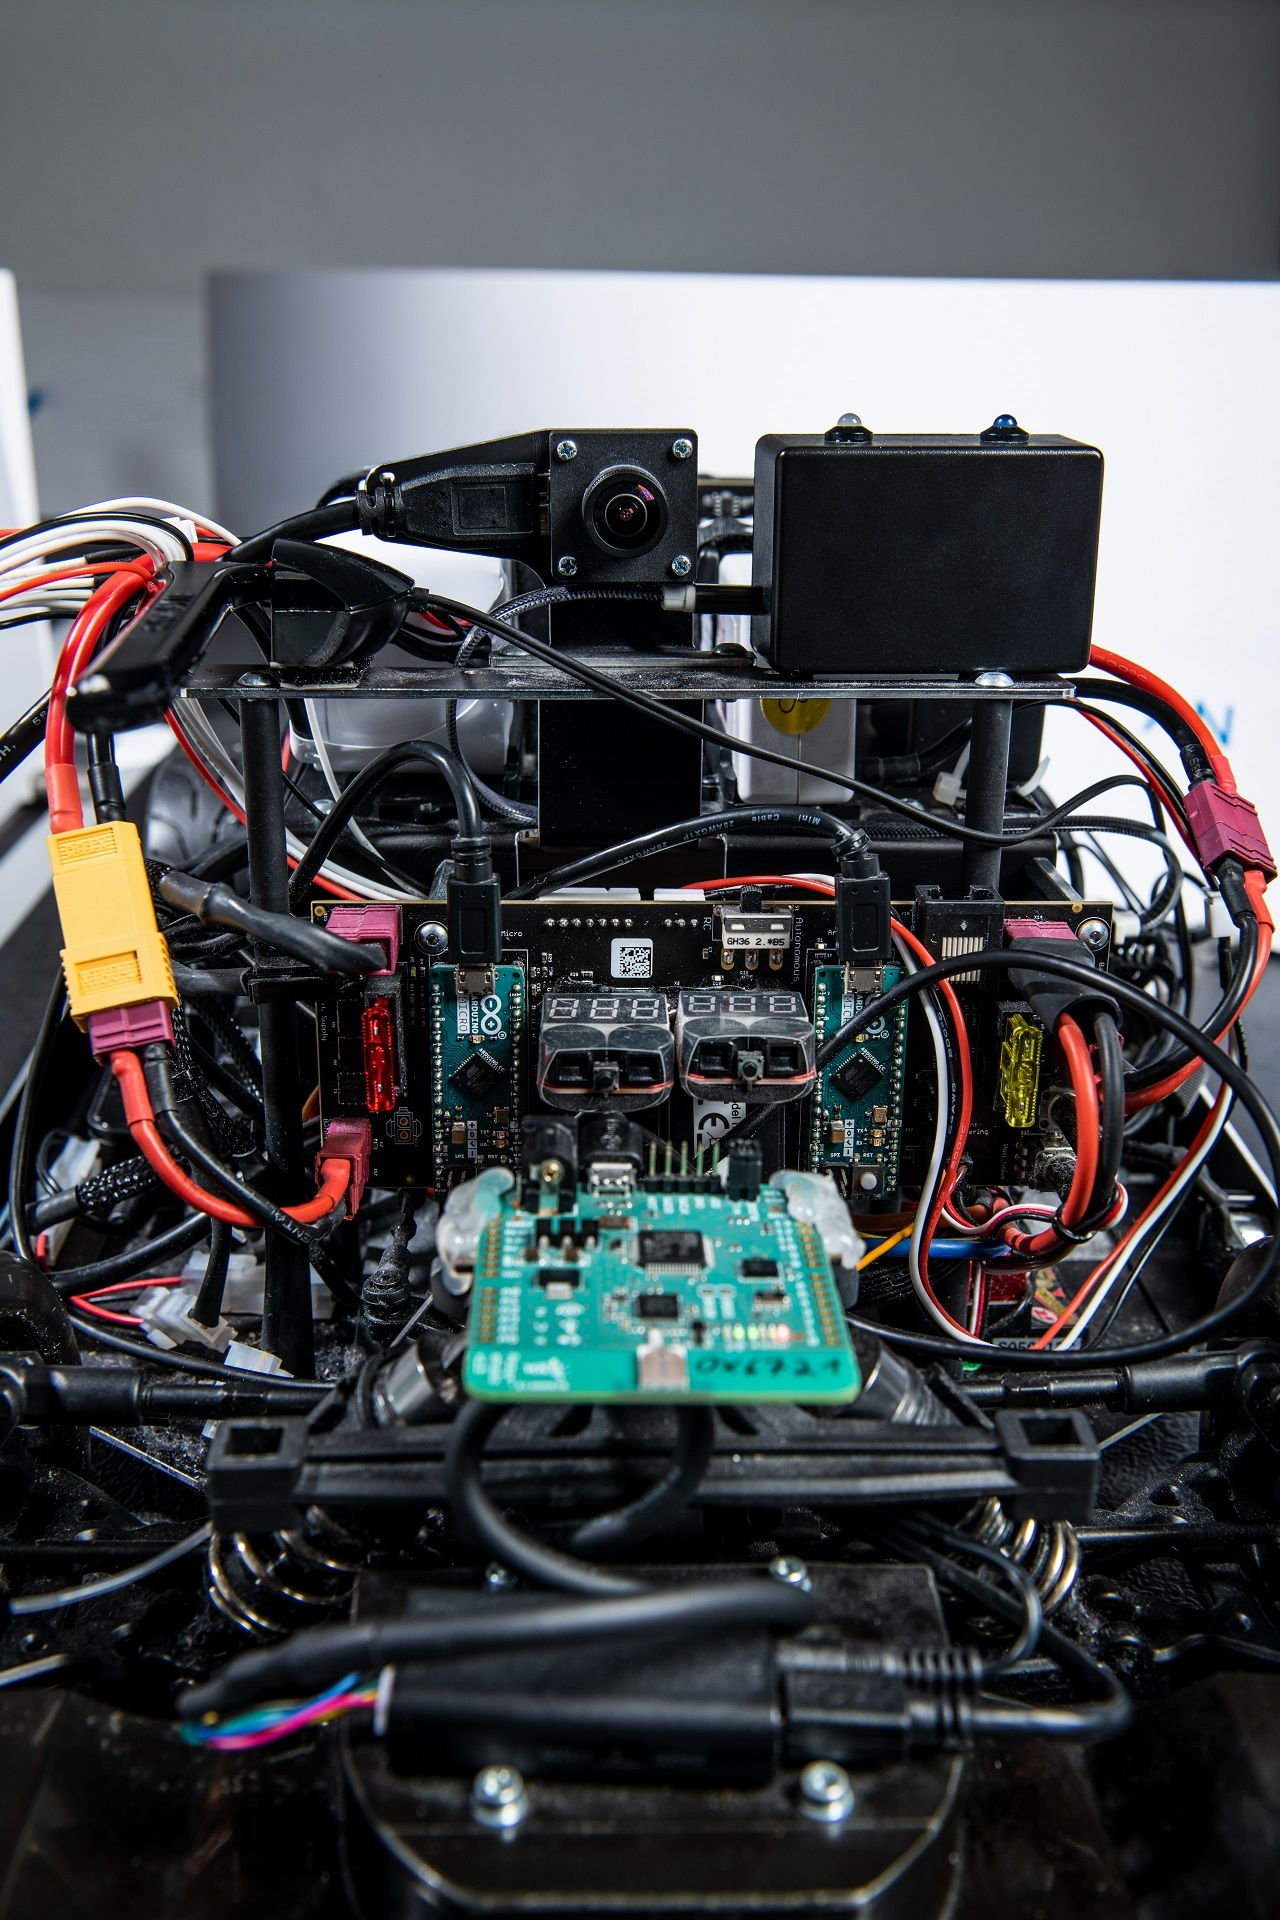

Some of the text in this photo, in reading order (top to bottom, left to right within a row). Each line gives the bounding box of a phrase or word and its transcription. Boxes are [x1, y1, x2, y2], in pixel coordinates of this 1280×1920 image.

[751, 812, 780, 823] Cable
[797, 814, 821, 826] Mini
[703, 916, 712, 931] RC
[500, 929, 523, 937] Micro
[727, 937, 750, 945] GH36
[792, 917, 804, 983] Autonomous
[843, 995, 853, 1024] MICR
[856, 994, 864, 1015] ARD
[459, 996, 468, 1032] MICRO
[471, 995, 479, 1034] ARDUINO
[320, 1015, 329, 1041] Supply
[968, 1128, 989, 1137] ering
